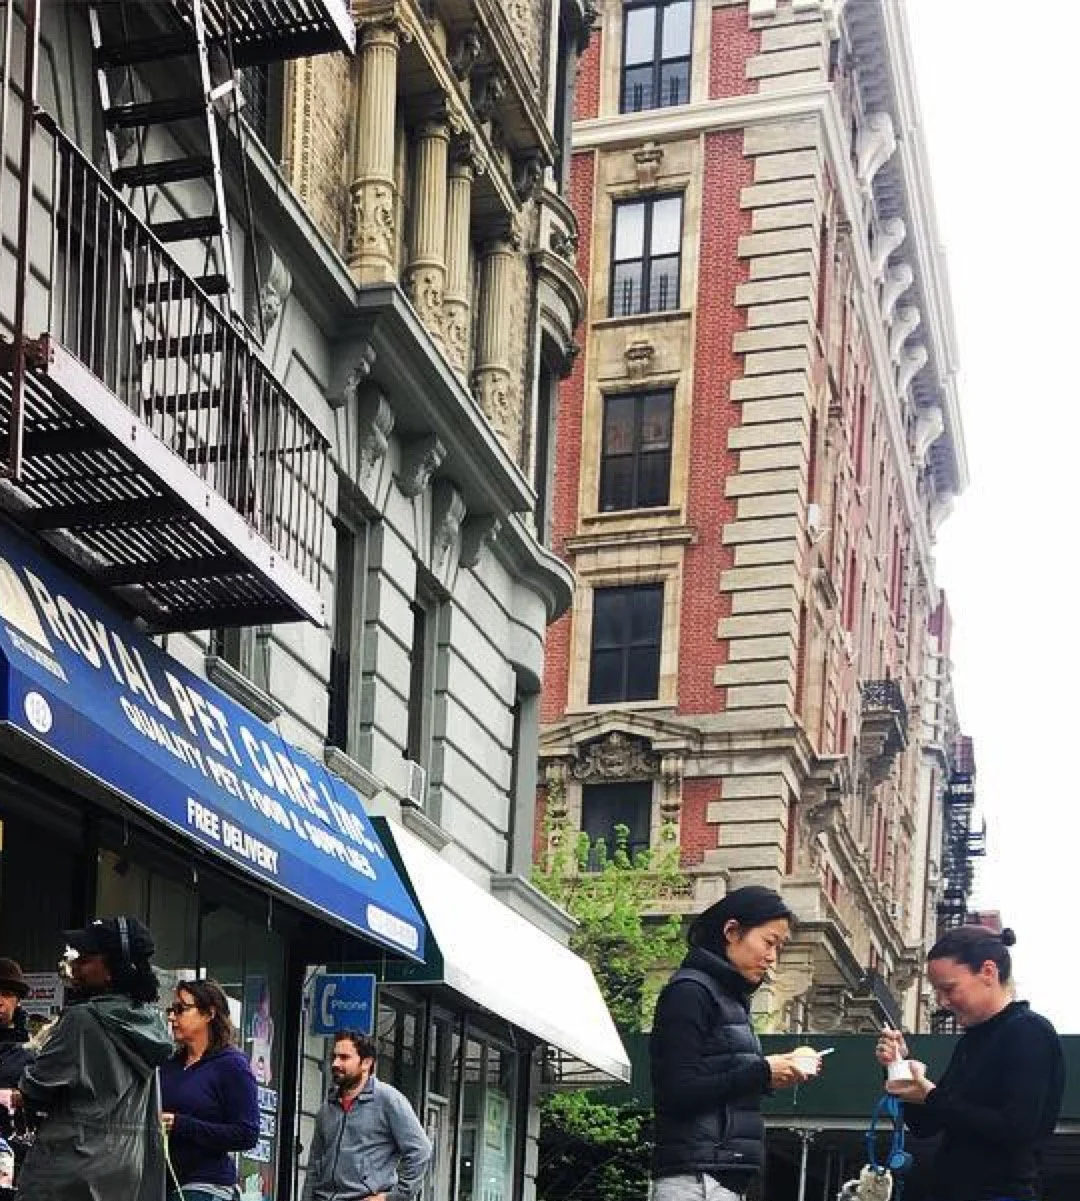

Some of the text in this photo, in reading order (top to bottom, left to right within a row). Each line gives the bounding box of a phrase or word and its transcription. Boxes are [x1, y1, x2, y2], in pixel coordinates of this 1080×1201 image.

[23, 566, 176, 721] ROYAL
[165, 670, 242, 767] PET
[240, 726, 331, 825] CARE
[120, 696, 377, 880] QUALITY PET FOOD & SUPPLIES
[187, 797, 279, 874] FREE DELIVERY
[331, 999, 368, 1011] Phone
